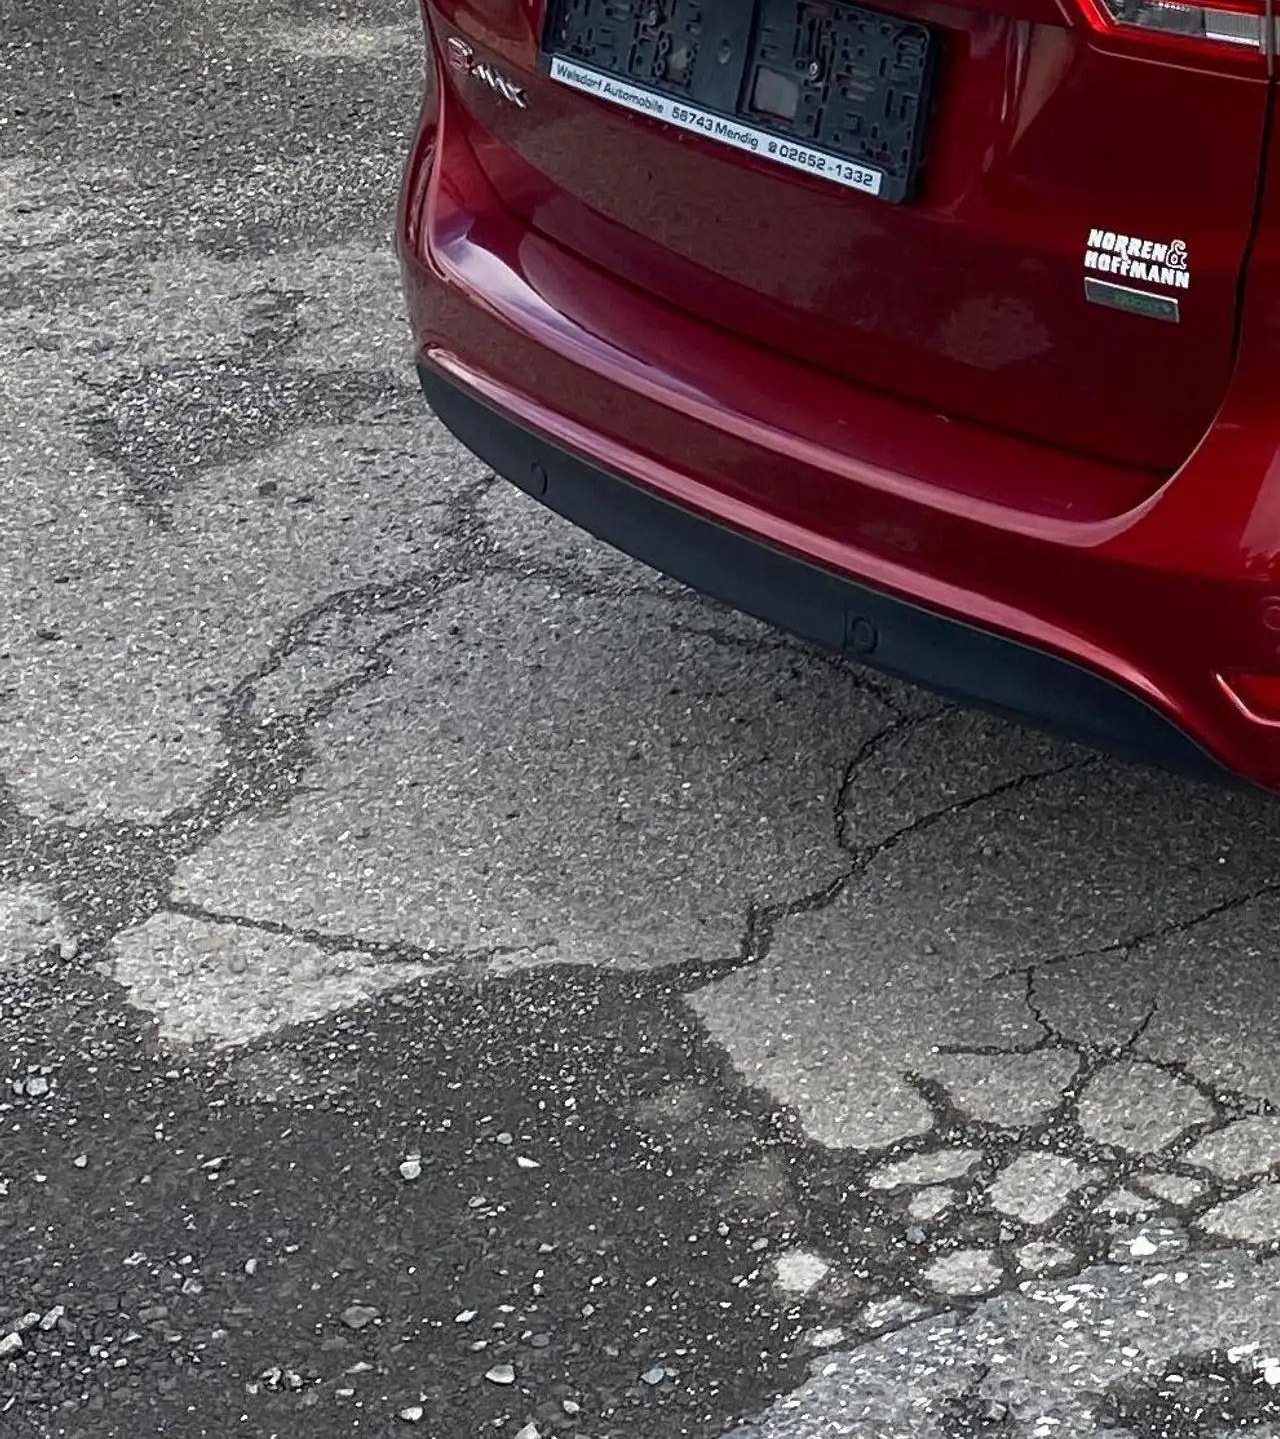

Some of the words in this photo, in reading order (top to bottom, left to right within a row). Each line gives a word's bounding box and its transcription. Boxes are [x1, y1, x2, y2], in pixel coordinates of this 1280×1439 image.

[604, 83, 665, 113] Automobile
[715, 122, 760, 151] Mendig
[1084, 249, 1190, 289] HOFFMANN
